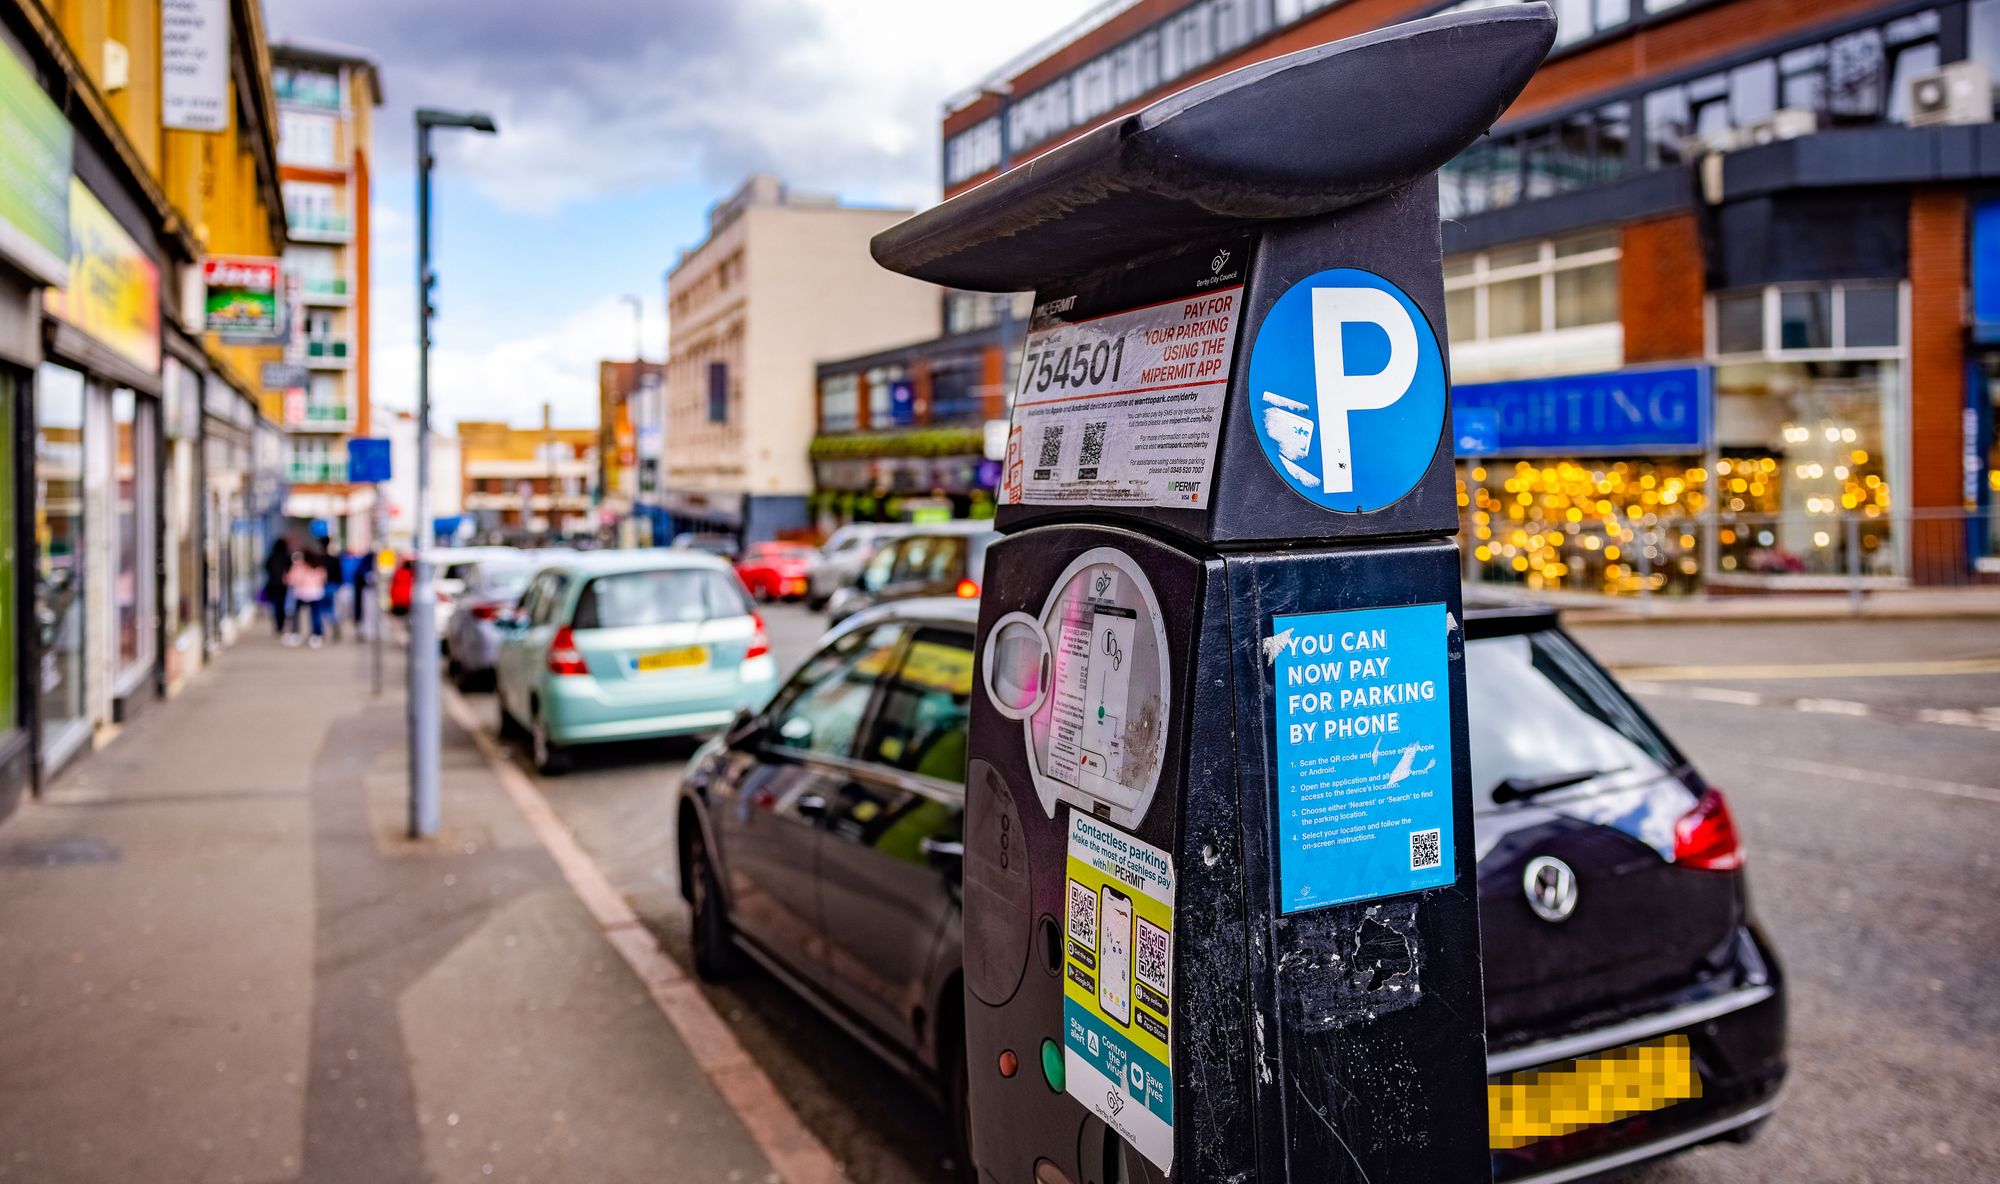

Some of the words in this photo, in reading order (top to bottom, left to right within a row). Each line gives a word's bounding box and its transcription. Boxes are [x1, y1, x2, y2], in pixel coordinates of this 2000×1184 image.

[1197, 279, 1209, 287] Derby
[1210, 276, 1219, 284] City
[1220, 270, 1237, 282] Council
[1183, 300, 1206, 319] PAY
[1207, 294, 1233, 315] FOR
[1144, 326, 1174, 345] YOUR
[1175, 315, 1229, 340] PARKING
[1162, 341, 1199, 361] USING
[1199, 337, 1225, 356] THE
[1020, 336, 1125, 394] 754501
[1140, 362, 1196, 384] MIPERMIT
[1195, 358, 1222, 377] APP
[1312, 287, 1418, 493] P
[1050, 406, 1062, 415] Apple
[1071, 403, 1089, 412] Android
[1089, 401, 1107, 410] devices
[1112, 399, 1128, 408] online
[1128, 398, 1134, 406] at
[1133, 391, 1198, 407] wanttopark.com/derby
[1462, 381, 1685, 437] GHTING
[1168, 414, 1212, 424] mipermit.com/help
[1156, 440, 1208, 450] wanttopark.com/derby
[1157, 432, 1181, 440] information
[1200, 430, 1209, 438] this
[1287, 633, 1335, 657] YOU
[1340, 628, 1388, 652] CAN
[1288, 661, 1343, 687] NOW
[1349, 656, 1390, 681] PAY
[1288, 691, 1334, 715] FOR
[1340, 680, 1435, 710] PARKING
[1289, 721, 1317, 745] BY
[1324, 712, 1399, 741] PHONE
[1290, 760, 1296, 768] 1.
[1299, 758, 1316, 767] Scan
[1318, 756, 1329, 764] the
[1330, 755, 1340, 763] QR
[1342, 752, 1357, 761] code
[1359, 751, 1371, 759] and
[1372, 748, 1396, 757] hoose
[1308, 766, 1336, 775] Android.
[1300, 782, 1318, 792] Open
[1319, 780, 1330, 788] the
[1331, 775, 1367, 788] application
[1368, 774, 1380, 782] and
[1300, 792, 1324, 801] access
[1333, 789, 1344, 797] the
[1346, 785, 1371, 795] device's
[1373, 781, 1400, 791] location.
[1301, 806, 1326, 815] Choose
[1327, 803, 1345, 812] either
[1421, 790, 1433, 798] find
[1301, 817, 1312, 826] the
[1314, 814, 1338, 825] parking
[1340, 809, 1367, 820] location.
[1301, 830, 1322, 840] Select
[1324, 829, 1338, 838] your
[1340, 824, 1366, 834] location
[1367, 822, 1379, 830] and
[1380, 819, 1400, 828] follow
[1401, 817, 1411, 825] the
[1076, 816, 1127, 854] Contactless
[1129, 842, 1166, 875] parking
[1302, 839, 1335, 851] on-screen
[1336, 832, 1376, 845] instructions.
[1072, 831, 1087, 847] Make
[1090, 840, 1099, 853] the
[1101, 845, 1117, 862] most
[1119, 854, 1125, 866] of
[1127, 858, 1155, 881] cashless
[1158, 875, 1170, 891] pay
[1092, 853, 1105, 871] with
[1106, 859, 1145, 891] MIPERMIT
[1075, 972, 1086, 987] Google
[1070, 1016, 1084, 1037] Stay
[1070, 1027, 1084, 1045] alert
[1144, 1019, 1152, 1032] App
[1153, 1025, 1165, 1040] Store
[1102, 1034, 1126, 1061] Control
[1108, 1050, 1120, 1067] the
[1106, 1059, 1122, 1079] virus
[1145, 1070, 1162, 1092] Save
[1095, 1103, 1108, 1121] Derby
[1109, 1114, 1118, 1128] City
[1119, 1122, 1136, 1143] Council
